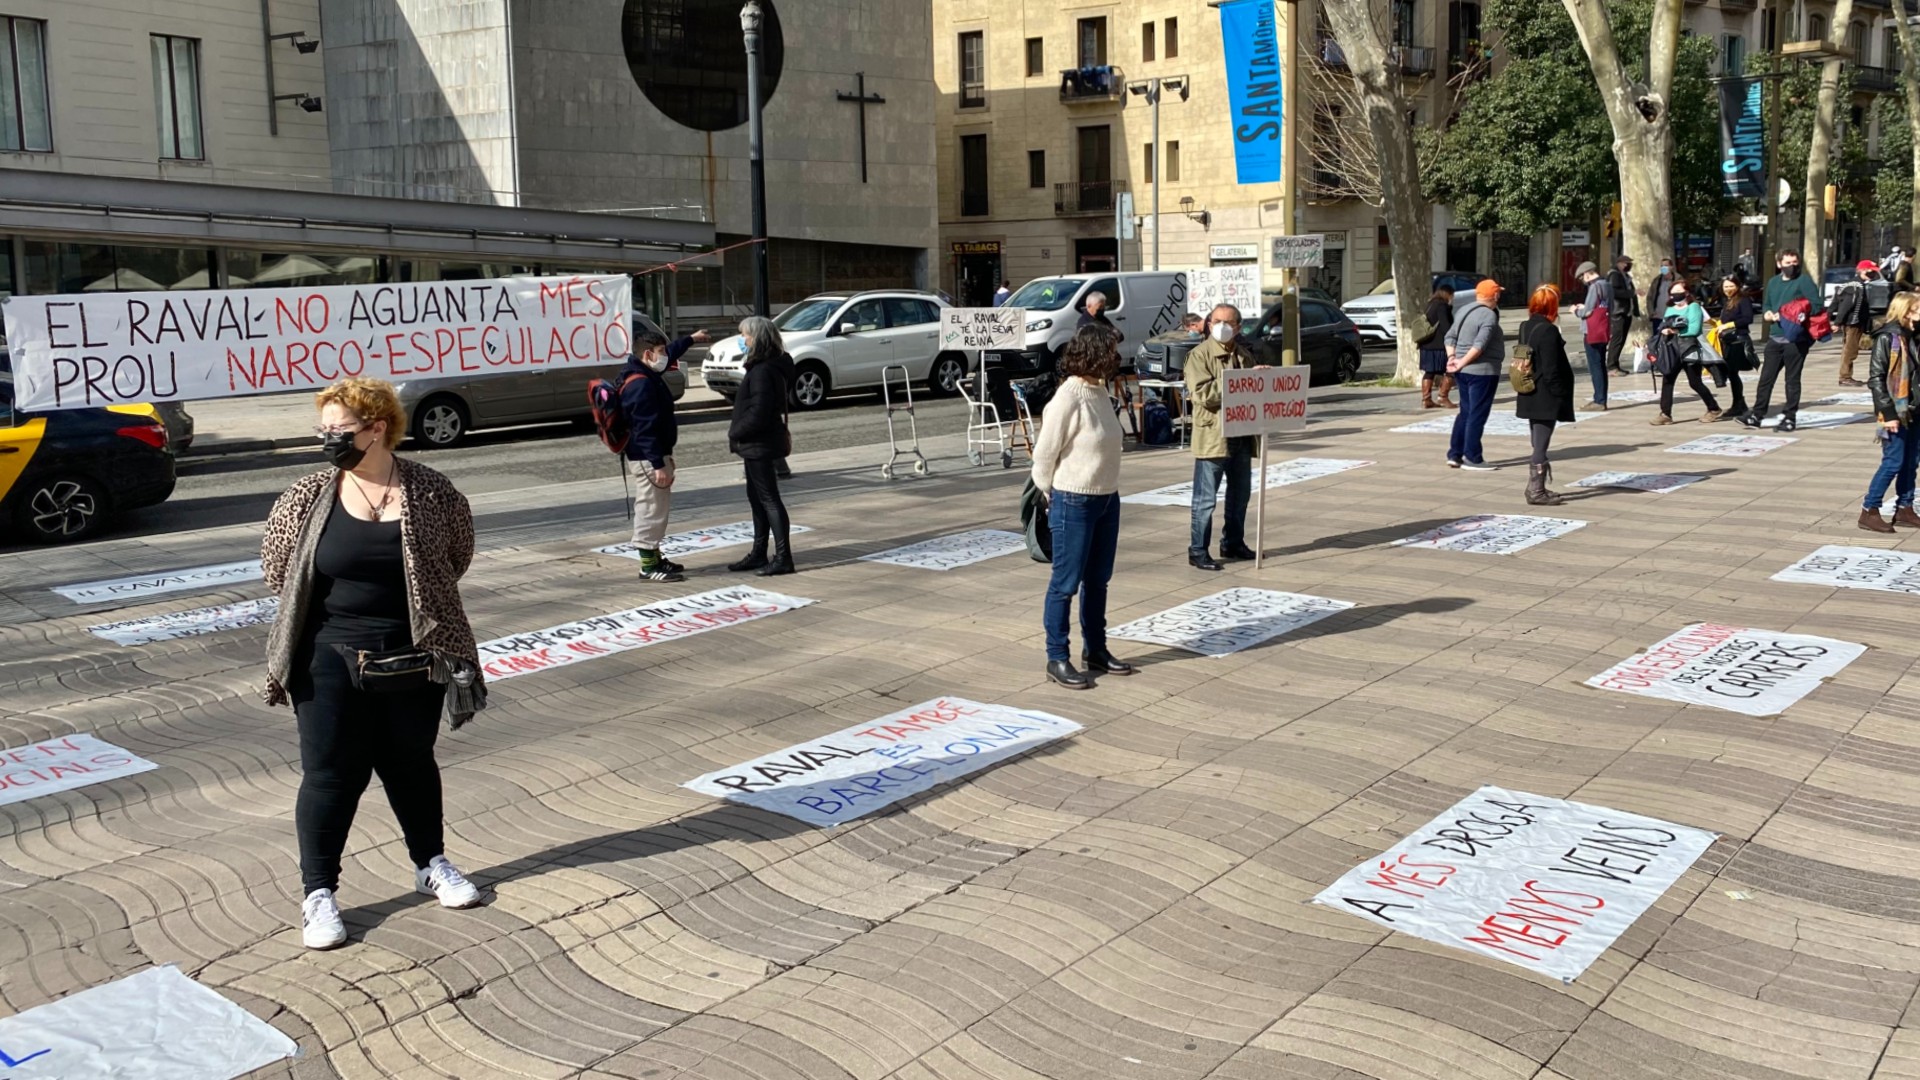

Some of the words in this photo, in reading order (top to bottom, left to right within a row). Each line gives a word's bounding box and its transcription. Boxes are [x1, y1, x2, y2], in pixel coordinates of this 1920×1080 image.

[964, 243, 998, 252] TABACS
[1215, 246, 1247, 257] GELATERÍA
[1221, 268, 1254, 282] RAVAL
[1204, 286, 1217, 298] NO
[46, 301, 108, 348] EL
[128, 296, 269, 346] RAVAL
[276, 293, 329, 336] NO
[348, 286, 518, 330] AGUANTA
[540, 279, 605, 319] MÉS
[950, 314, 963, 324] EL
[974, 313, 1001, 324] RAVAL
[960, 321, 971, 334] TÉ
[976, 325, 988, 334] LA
[992, 324, 1018, 335] SEVA
[964, 336, 995, 347] REINA
[53, 351, 178, 407] PROU
[1228, 374, 1265, 394] BARRIO
[1272, 374, 1302, 393] UNIDO
[1225, 401, 1257, 423] BARRIO
[1263, 399, 1306, 420] PROTEGIDO
[107, 576, 186, 594] RAVAL
[1672, 665, 1717, 685] DELS
[1705, 641, 1828, 698] CARRERS
[713, 743, 877, 793] RAVAL
[854, 700, 982, 742] TAMBÉ
[1420, 799, 1550, 857] DROGA
[1366, 853, 1457, 898] MÉS
[1341, 897, 1414, 922] A
[1464, 879, 1606, 961] MENYS
